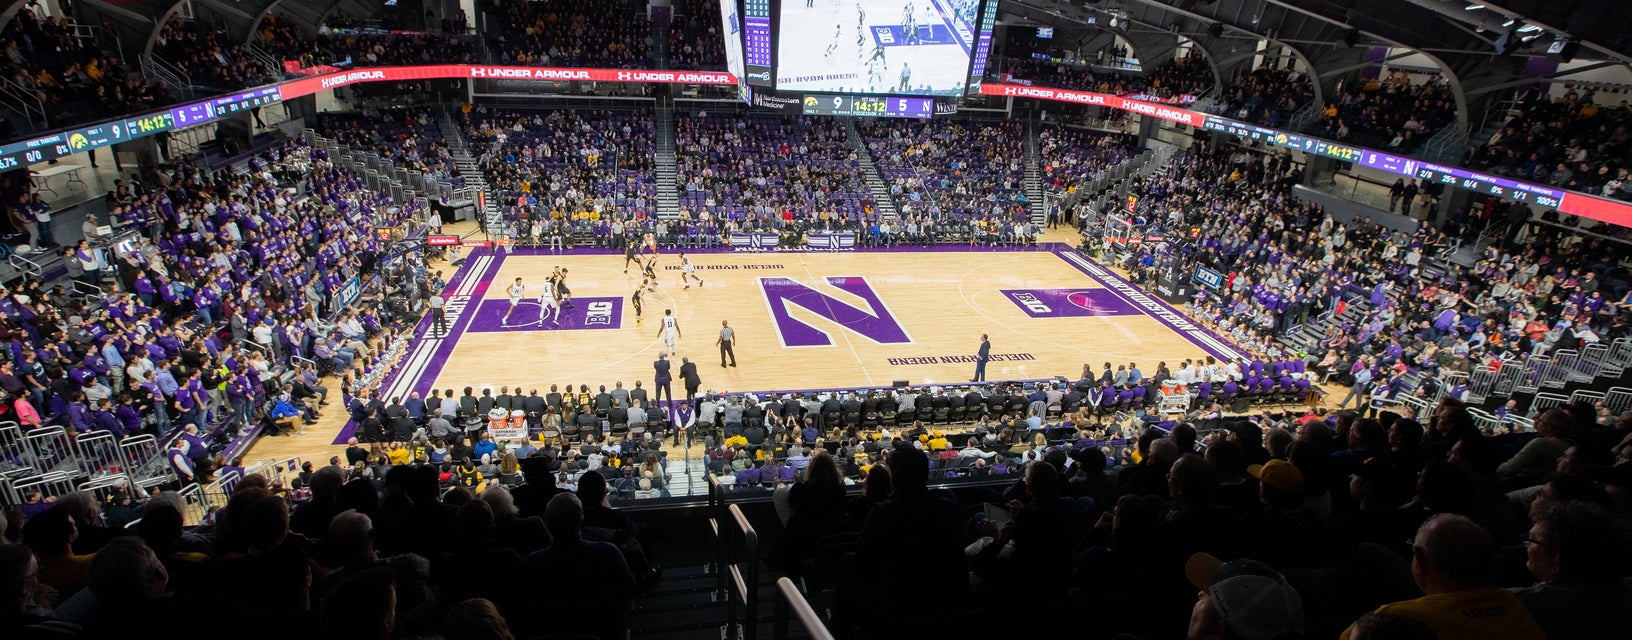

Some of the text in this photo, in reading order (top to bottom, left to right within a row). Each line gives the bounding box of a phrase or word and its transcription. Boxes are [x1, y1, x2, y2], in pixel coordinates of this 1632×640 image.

[488, 68, 531, 77] UNDER
[634, 72, 675, 81] UNDER
[329, 74, 347, 86] UNDER
[1018, 89, 1054, 98] UNDER
[763, 95, 799, 104] Northwestern
[833, 96, 842, 109] 9
[899, 99, 907, 111] 5
[204, 102, 214, 118] N
[854, 101, 885, 112] 14:12
[923, 101, 930, 112] N
[1131, 103, 1155, 113] UNDER
[179, 110, 186, 123] 5
[138, 116, 165, 133] 14:12
[111, 125, 120, 138] 9
[40, 136, 60, 144] THROWS
[1306, 140, 1312, 149] 9
[56, 144, 68, 154] 0%
[1327, 145, 1353, 159] 14:12
[26, 150, 42, 162] 0/0
[1368, 154, 1376, 164] 5
[1403, 160, 1415, 175] N
[1441, 175, 1457, 184] 25%
[1464, 180, 1478, 189] 0/4
[1490, 186, 1503, 195] 0%
[1513, 191, 1527, 200] 1/1
[1531, 186, 1552, 195] THROWS
[1536, 196, 1558, 207] 100%
[751, 235, 760, 247] N
[830, 236, 839, 249] N
[1198, 268, 1219, 285] BTN
[1099, 274, 1199, 331] NORTHWESTERN
[756, 276, 916, 348] N
[887, 356, 938, 366] ARENA
